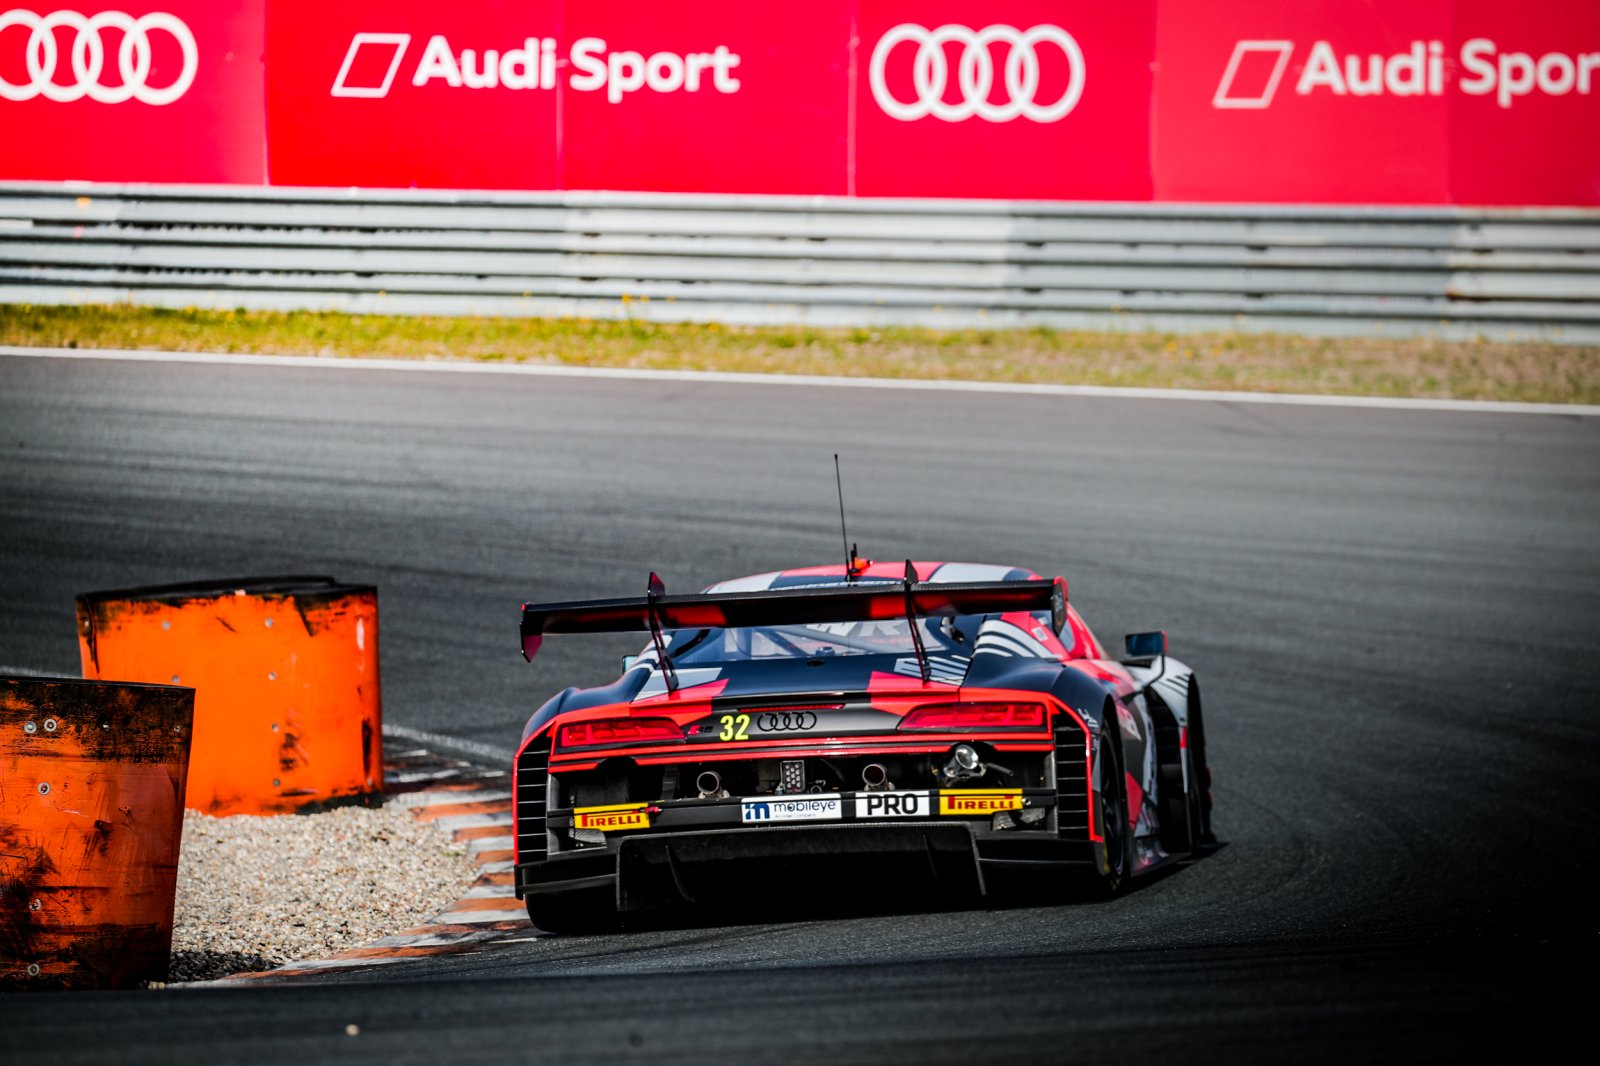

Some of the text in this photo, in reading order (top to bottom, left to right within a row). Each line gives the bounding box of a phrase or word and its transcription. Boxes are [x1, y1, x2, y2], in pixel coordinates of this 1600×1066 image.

[412, 35, 741, 104] Audi Sport
[1295, 40, 1444, 95] Audi
[719, 714, 750, 741] 32
[774, 800, 836, 812] mobileye
[867, 793, 918, 815] PRO
[947, 794, 1014, 810] PIRELLI
[581, 809, 641, 827] PIRELLI
